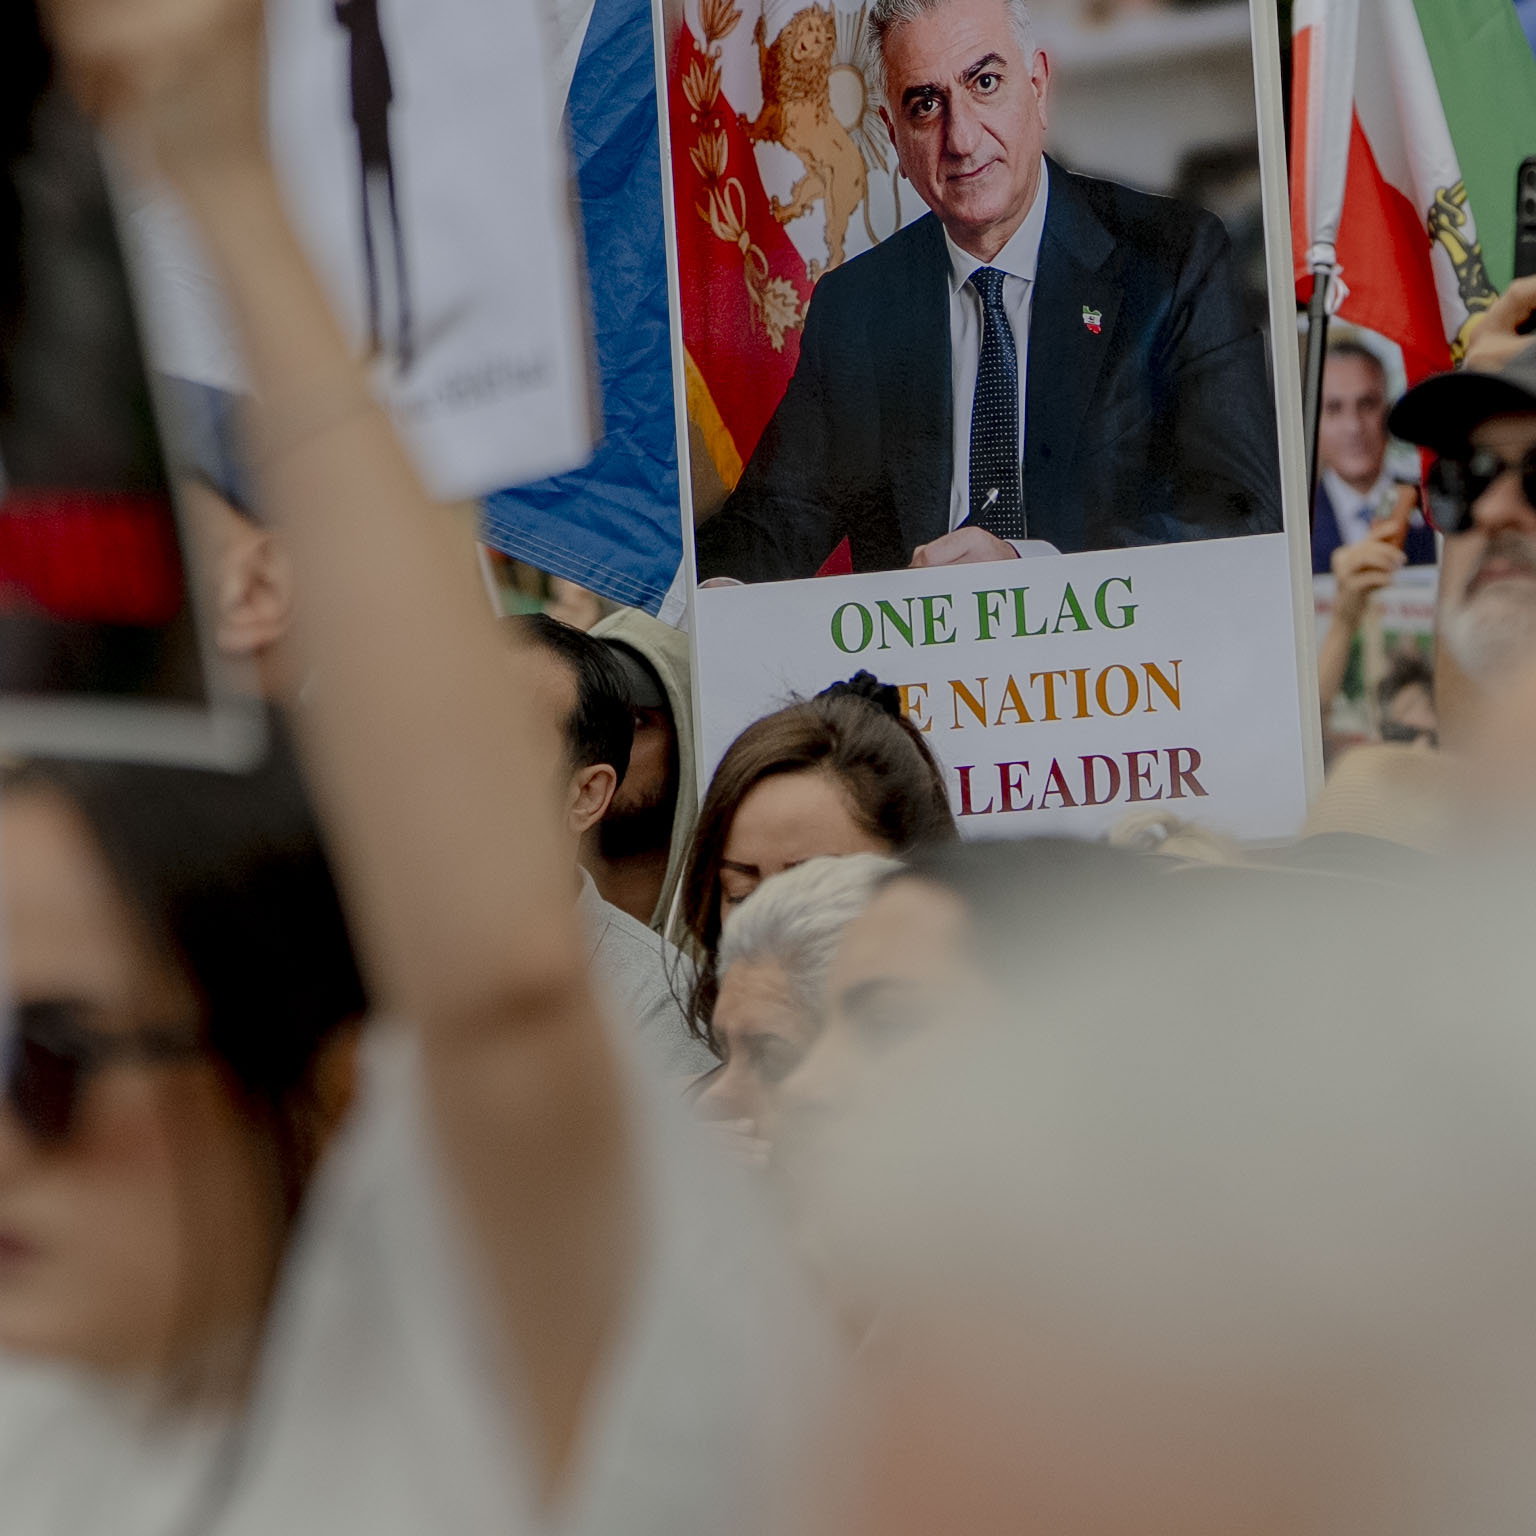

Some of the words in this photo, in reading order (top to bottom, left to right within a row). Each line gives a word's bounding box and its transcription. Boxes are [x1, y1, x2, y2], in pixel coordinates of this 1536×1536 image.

[830, 593, 957, 654] ONE
[971, 576, 1138, 642] FLAG
[947, 659, 1185, 730] NATION
[953, 747, 1209, 817] LEADER
